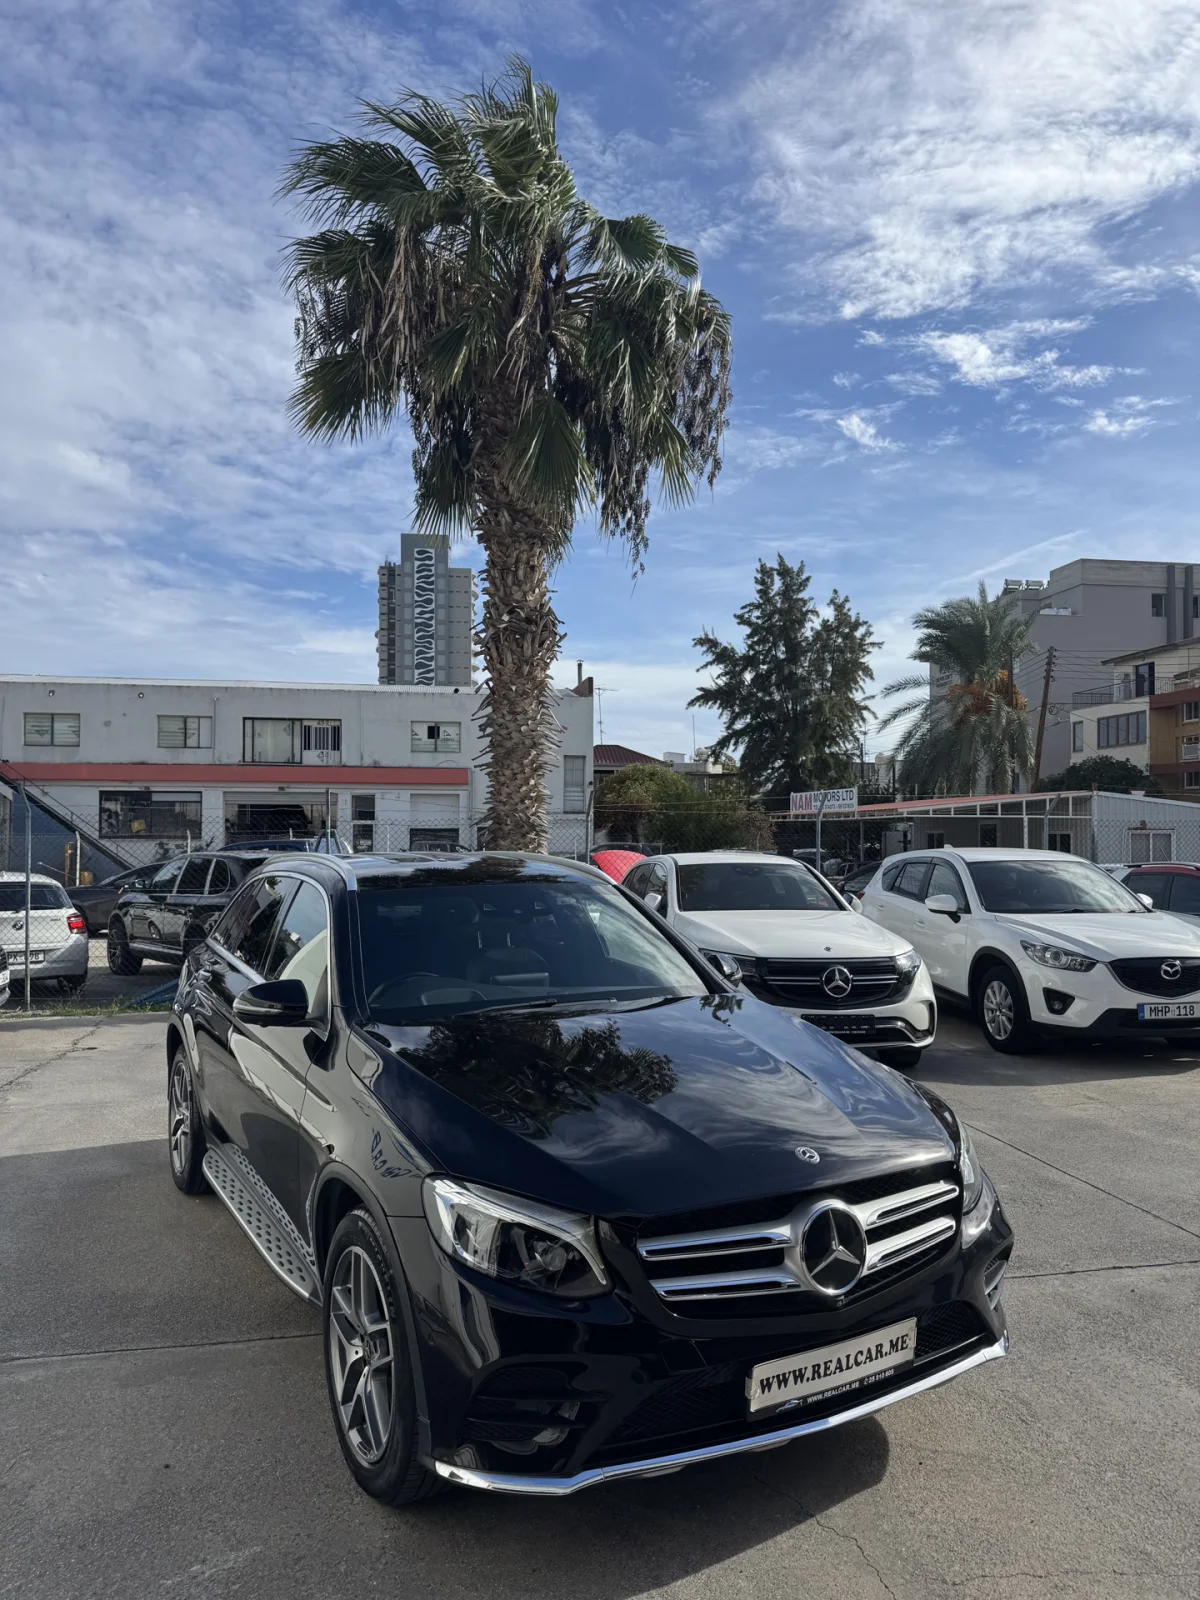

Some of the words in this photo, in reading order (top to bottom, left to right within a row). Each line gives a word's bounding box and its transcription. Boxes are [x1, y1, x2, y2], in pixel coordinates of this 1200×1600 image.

[791, 794, 812, 811] NAM
[813, 791, 840, 802] MOORS
[842, 790, 855, 801] LTD
[1149, 1006, 1170, 1017] MHP
[1176, 1005, 1195, 1017] 118
[759, 1334, 909, 1395] WWW.REALCAR.ME
[807, 1381, 860, 1404] WWW.REALCAR.ME
